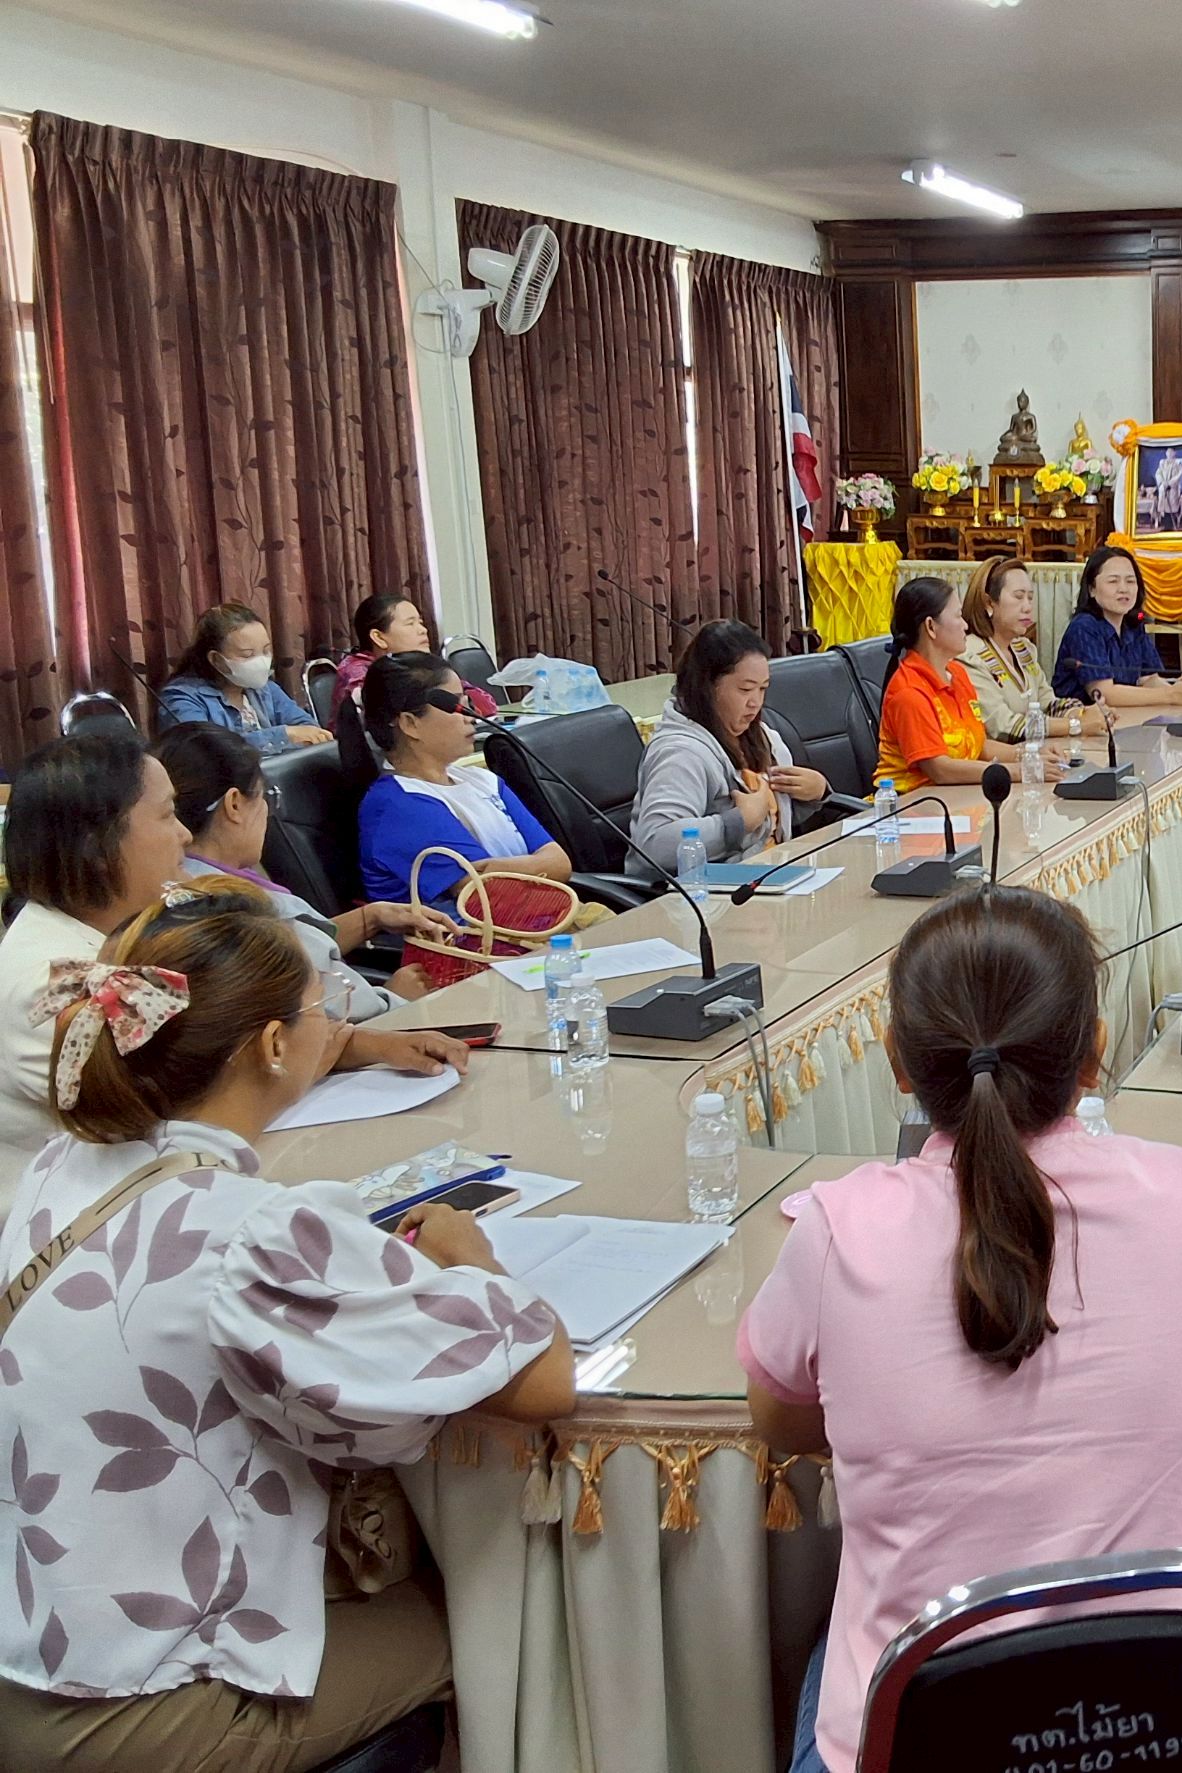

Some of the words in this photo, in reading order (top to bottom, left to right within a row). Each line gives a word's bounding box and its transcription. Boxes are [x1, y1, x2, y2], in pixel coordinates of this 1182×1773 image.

[5, 1225, 75, 1313] LOVE
[1011, 1700, 1155, 1754] ทต.ไม้ยา
